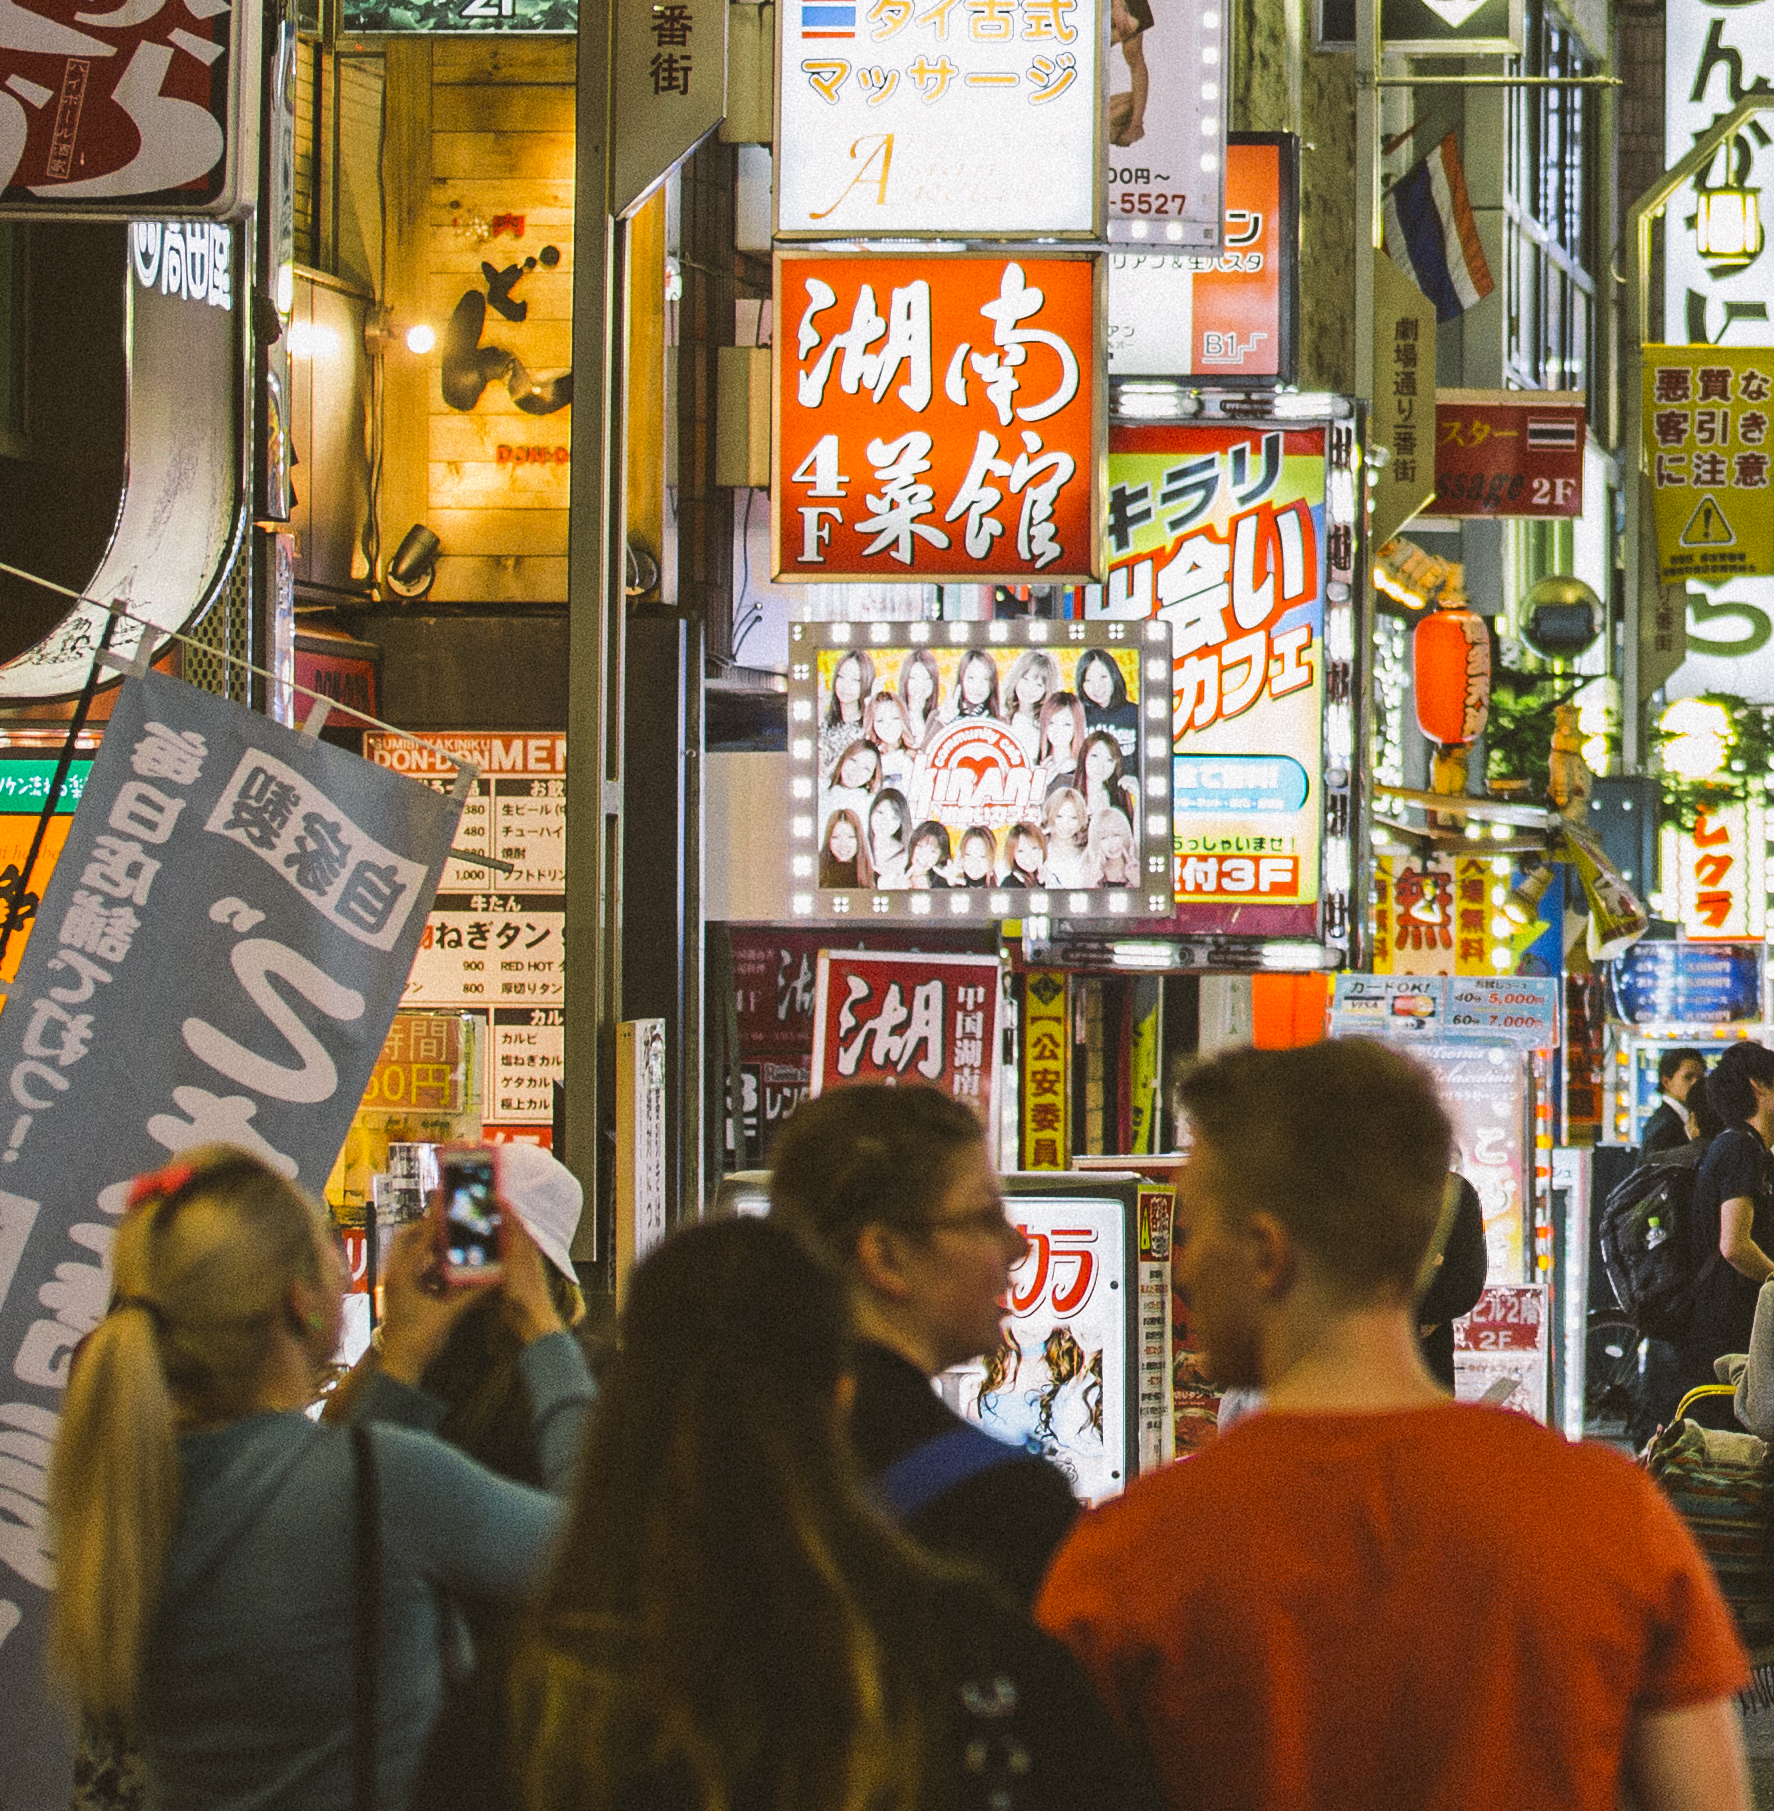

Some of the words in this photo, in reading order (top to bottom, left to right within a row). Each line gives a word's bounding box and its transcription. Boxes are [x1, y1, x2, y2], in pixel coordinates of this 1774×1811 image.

[799, 51, 1079, 107] マッサージ
[797, 261, 1081, 427] 湖南
[1654, 367, 1770, 404] 悪質な
[1654, 410, 1770, 447] 客引き
[1655, 453, 1770, 489] に注意
[853, 430, 1076, 570] 菜館
[1106, 433, 1286, 553] キラリ
[1532, 479, 1575, 506] 2F
[502, 803, 550, 816] 生ビール
[502, 826, 563, 837] チューハイ
[456, 870, 485, 881] 1,000
[471, 895, 521, 912] 牛たん
[463, 962, 484, 971] 900
[501, 962, 524, 972] RED
[528, 962, 554, 972] HOT
